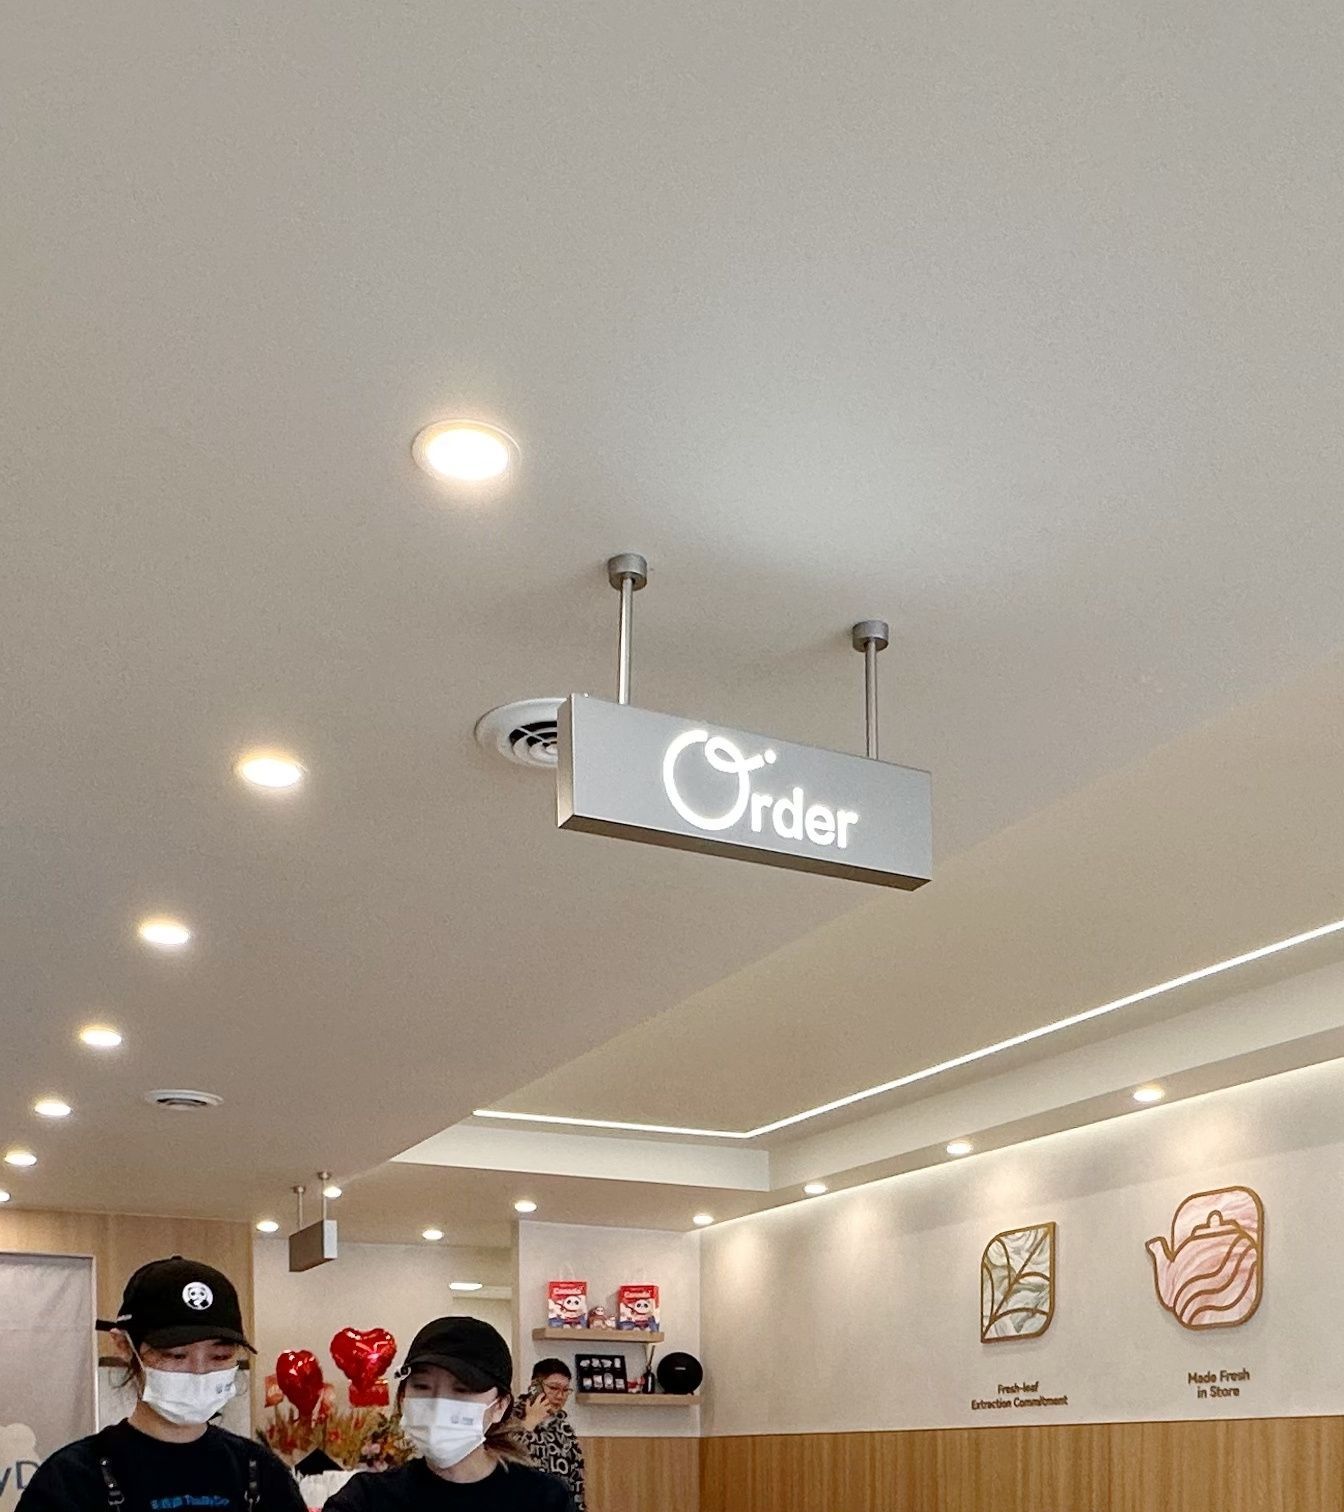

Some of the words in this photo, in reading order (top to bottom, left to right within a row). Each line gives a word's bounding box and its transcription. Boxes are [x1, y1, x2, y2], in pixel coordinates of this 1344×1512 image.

[663, 729, 861, 849] Order
[1188, 1371, 1217, 1384] Made
[1220, 1368, 1250, 1382] Fresh
[998, 1381, 1039, 1394] Fresh-leaf
[1197, 1386, 1207, 1398] in
[1210, 1385, 1240, 1398] Store
[971, 1399, 1012, 1410] Extraction
[1013, 1395, 1068, 1408] Commitment
